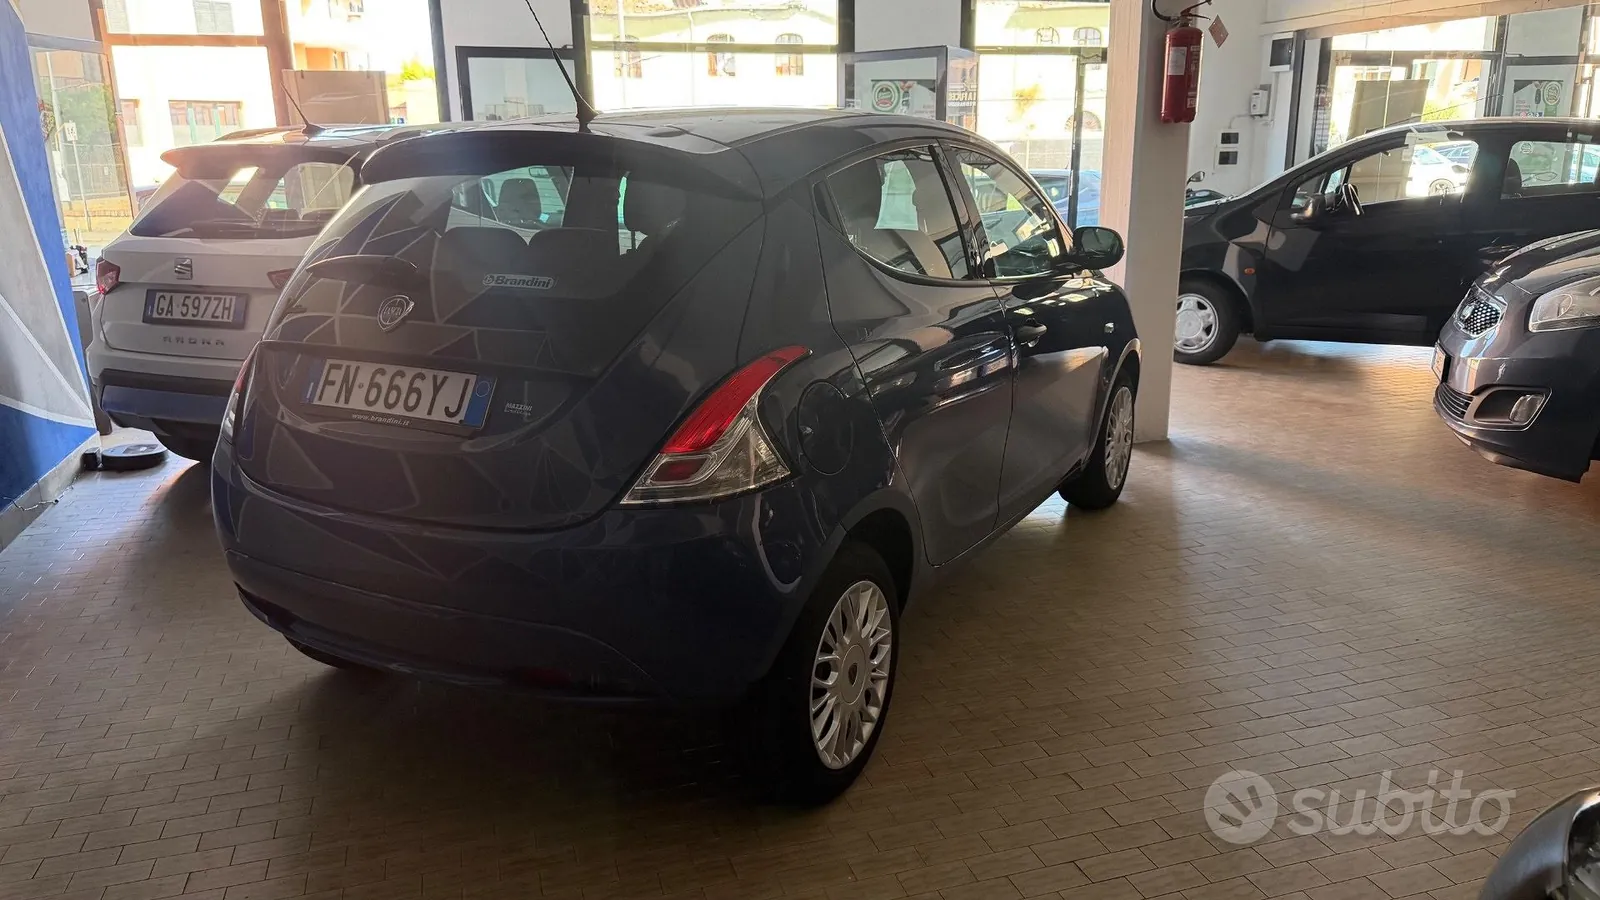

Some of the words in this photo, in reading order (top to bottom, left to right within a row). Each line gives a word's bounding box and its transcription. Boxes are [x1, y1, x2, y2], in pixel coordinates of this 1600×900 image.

[495, 274, 551, 288] Brandini
[180, 295, 233, 320] 597ZH
[317, 363, 361, 405] FN
[363, 367, 471, 419] 666YJ
[351, 412, 411, 427] www.brandini.it
